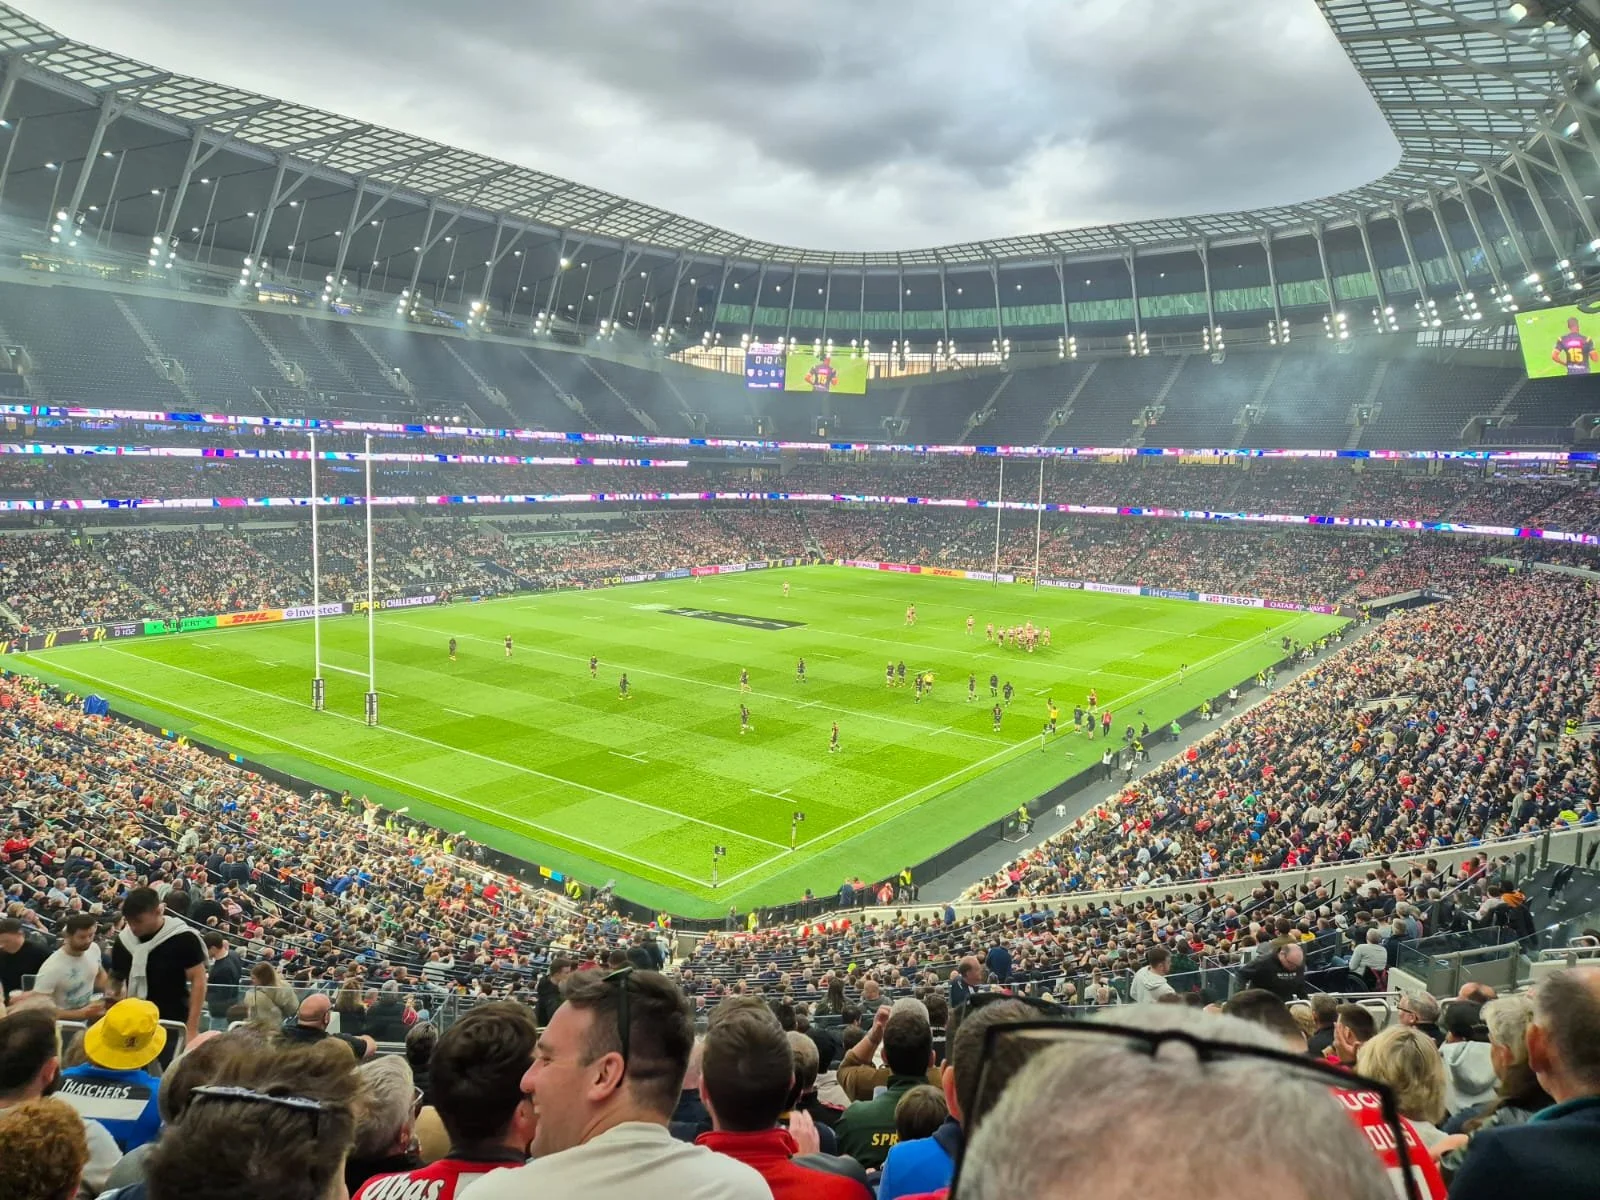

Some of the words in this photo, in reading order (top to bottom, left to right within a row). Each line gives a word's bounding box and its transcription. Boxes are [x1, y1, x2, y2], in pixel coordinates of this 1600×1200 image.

[1149, 588, 1168, 598] IHG
[423, 595, 436, 603] CUP
[1221, 596, 1256, 606] TISSOT
[1270, 601, 1294, 610] QATAR
[231, 612, 269, 623] DHL
[61, 1078, 132, 1099] THATCHERS
